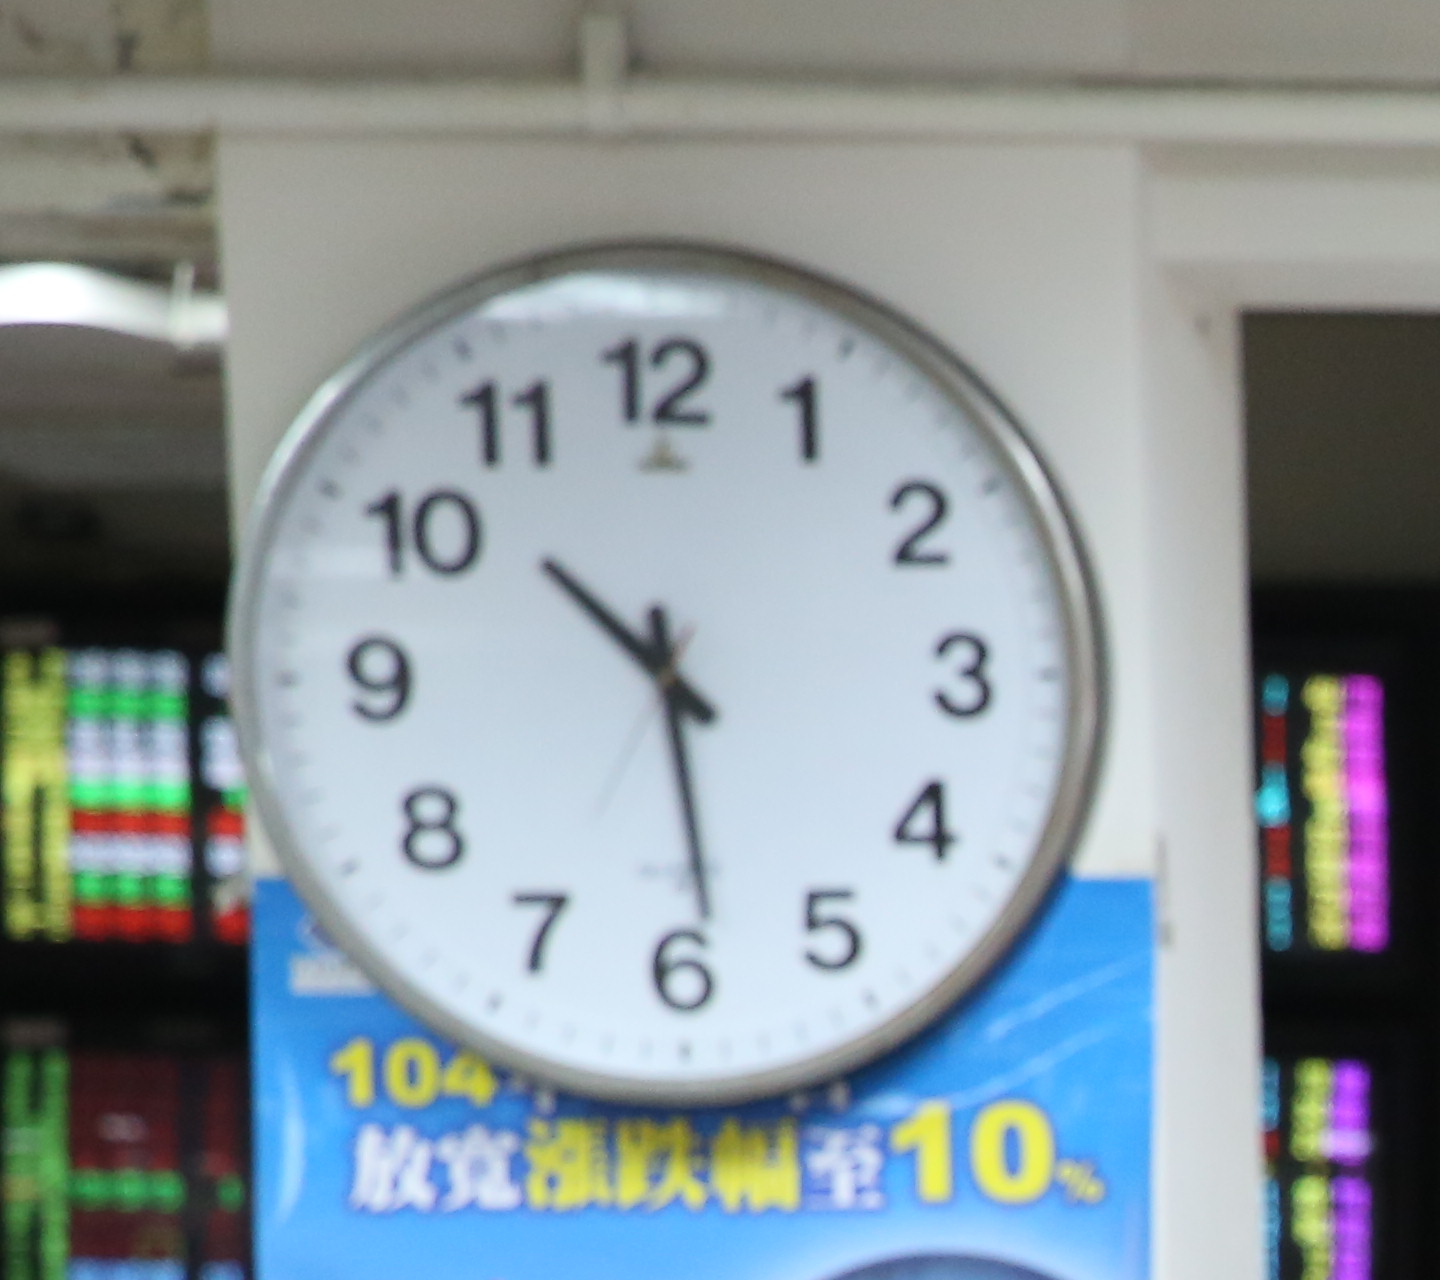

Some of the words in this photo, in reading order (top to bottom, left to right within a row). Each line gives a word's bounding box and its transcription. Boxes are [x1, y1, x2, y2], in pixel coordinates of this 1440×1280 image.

[461, 380, 552, 466] 11
[601, 337, 714, 428] 12
[779, 377, 820, 462] 1
[365, 488, 483, 577] 10
[887, 481, 950, 565] 2
[345, 635, 412, 722] 9
[931, 632, 992, 718] 3
[400, 786, 466, 870] 8
[892, 779, 957, 862] 4
[510, 890, 570, 974] 7
[651, 928, 714, 1013] 6
[803, 889, 861, 971] 5
